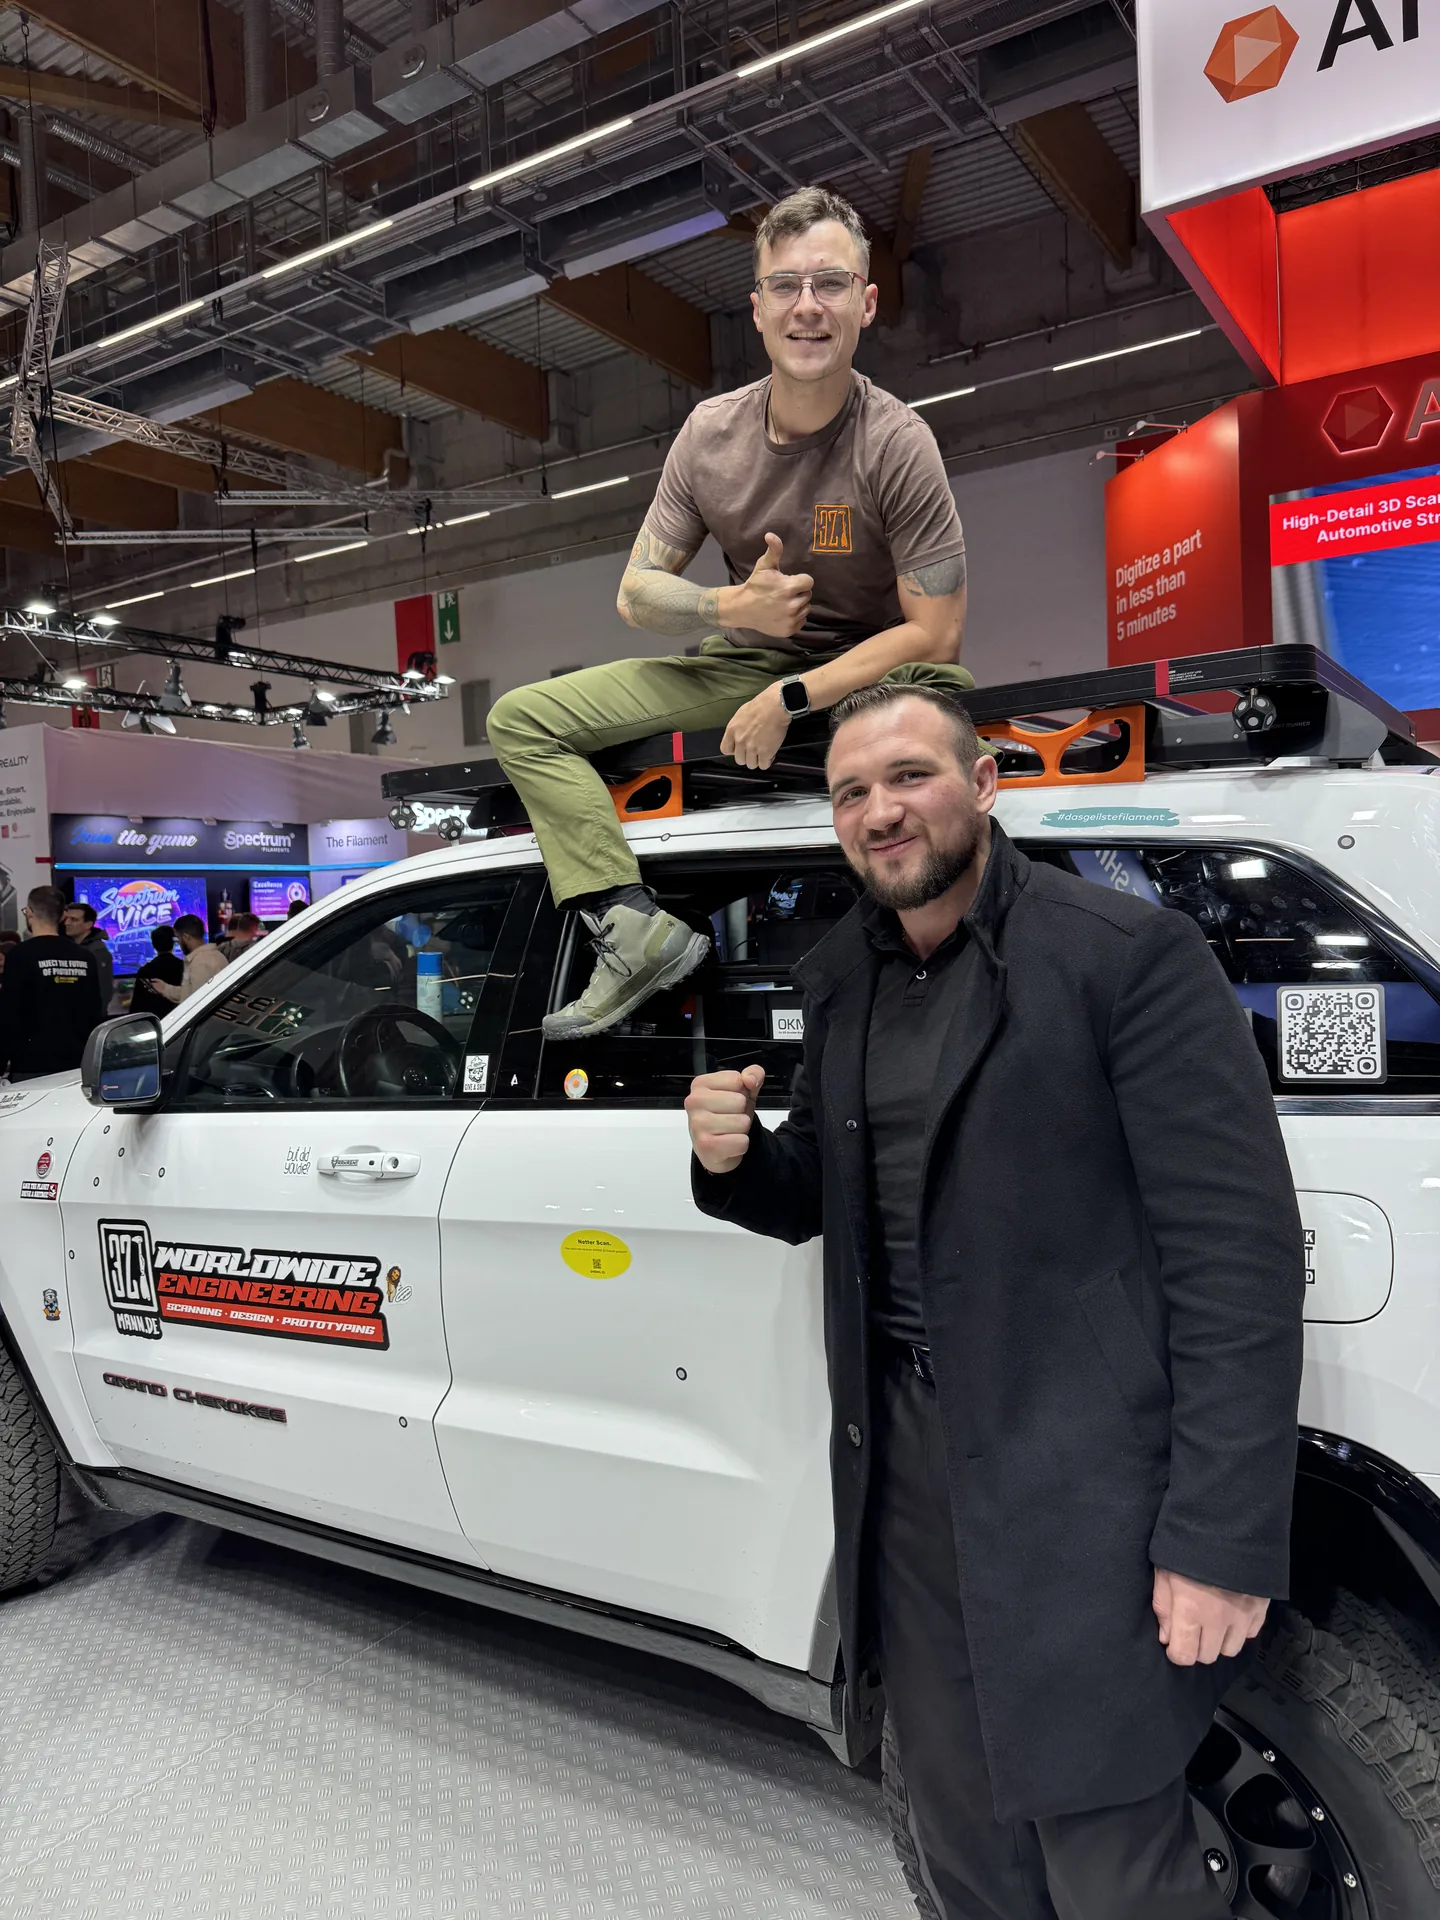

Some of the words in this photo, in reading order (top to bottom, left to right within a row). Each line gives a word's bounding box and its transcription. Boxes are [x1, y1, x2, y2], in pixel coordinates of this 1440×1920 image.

[1282, 502, 1374, 531] High-Detail
[1378, 498, 1402, 513] 3D
[1317, 517, 1413, 543] Automotive
[1116, 553, 1161, 588] Digitize
[1162, 547, 1171, 565] a
[1173, 528, 1202, 566] part
[1116, 595, 1127, 615] in
[1129, 585, 1154, 609] less
[1156, 569, 1186, 596] than
[1117, 620, 1125, 641] 5
[1126, 603, 1177, 637] minutes
[1057, 812, 1166, 822] #dasgeilstefilament
[117, 829, 147, 846] the
[145, 834, 198, 855] game
[326, 836, 345, 848] The
[346, 834, 389, 847] Filament
[97, 885, 180, 920] Spectrum
[154, 1246, 378, 1287] WORLDWIDE
[157, 1273, 380, 1314] ENGINEERING
[116, 1313, 160, 1336] MANN.DE
[166, 1303, 222, 1317] SCANNING
[229, 1310, 274, 1324] DESIGN
[281, 1316, 376, 1335] PROTOTYPING
[102, 1372, 168, 1397] GRAND
[172, 1387, 287, 1423] CHEROKEE
